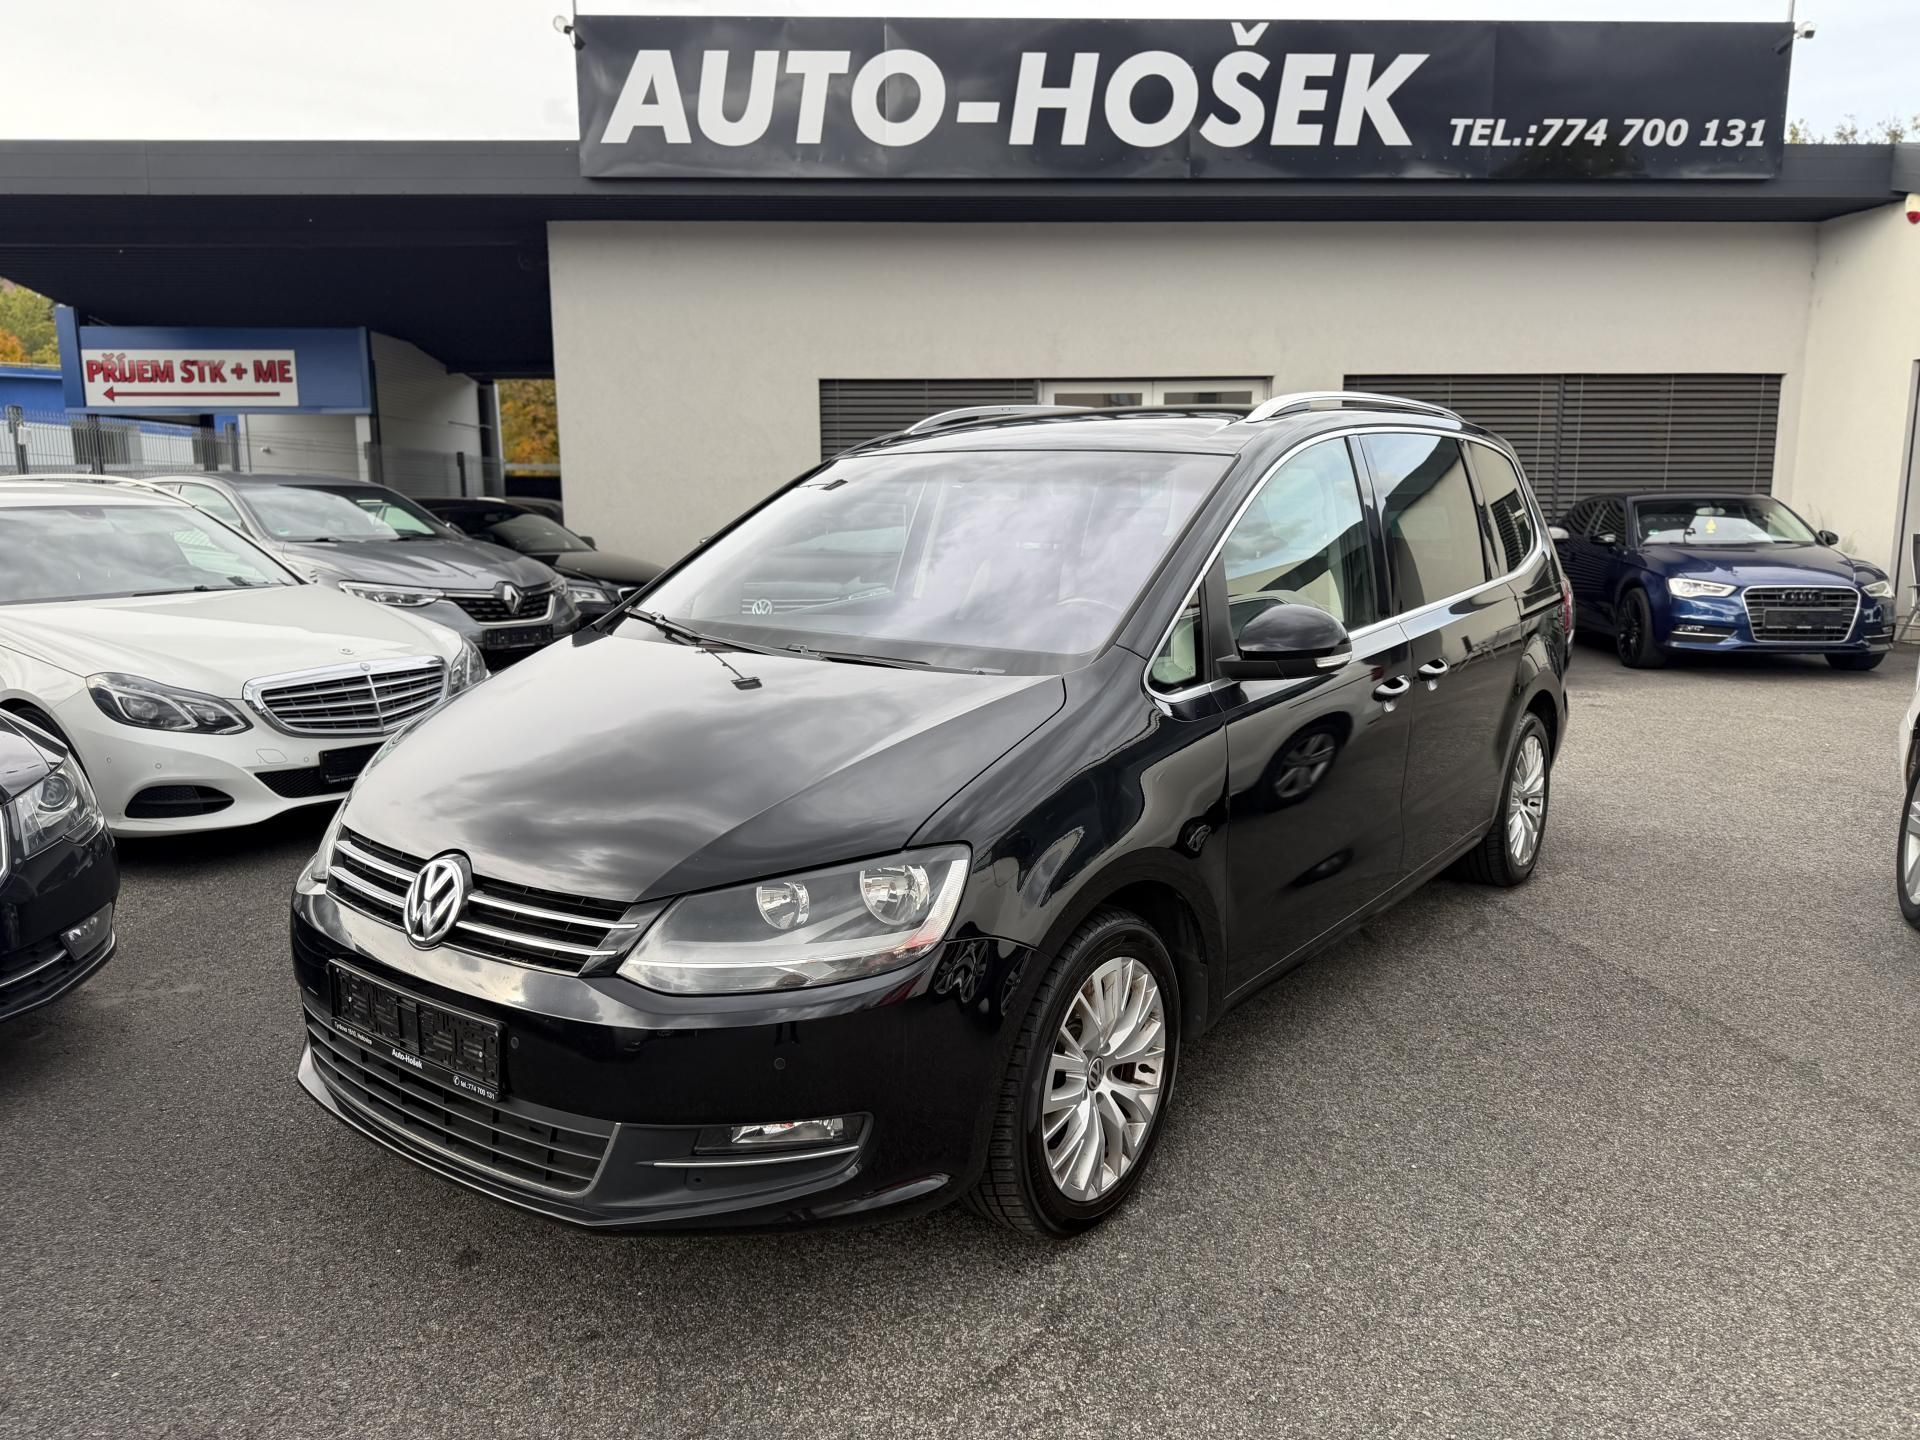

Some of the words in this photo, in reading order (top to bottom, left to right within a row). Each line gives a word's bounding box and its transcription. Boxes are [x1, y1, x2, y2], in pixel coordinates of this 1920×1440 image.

[600, 22, 1429, 148] AUTO-HOŠEK
[1450, 118, 1608, 148] TEL.:774
[1619, 118, 1689, 148] 700
[1699, 118, 1766, 148] 131
[86, 352, 175, 384] PŘÍJEM
[179, 360, 227, 384] STK
[254, 359, 293, 384] ME
